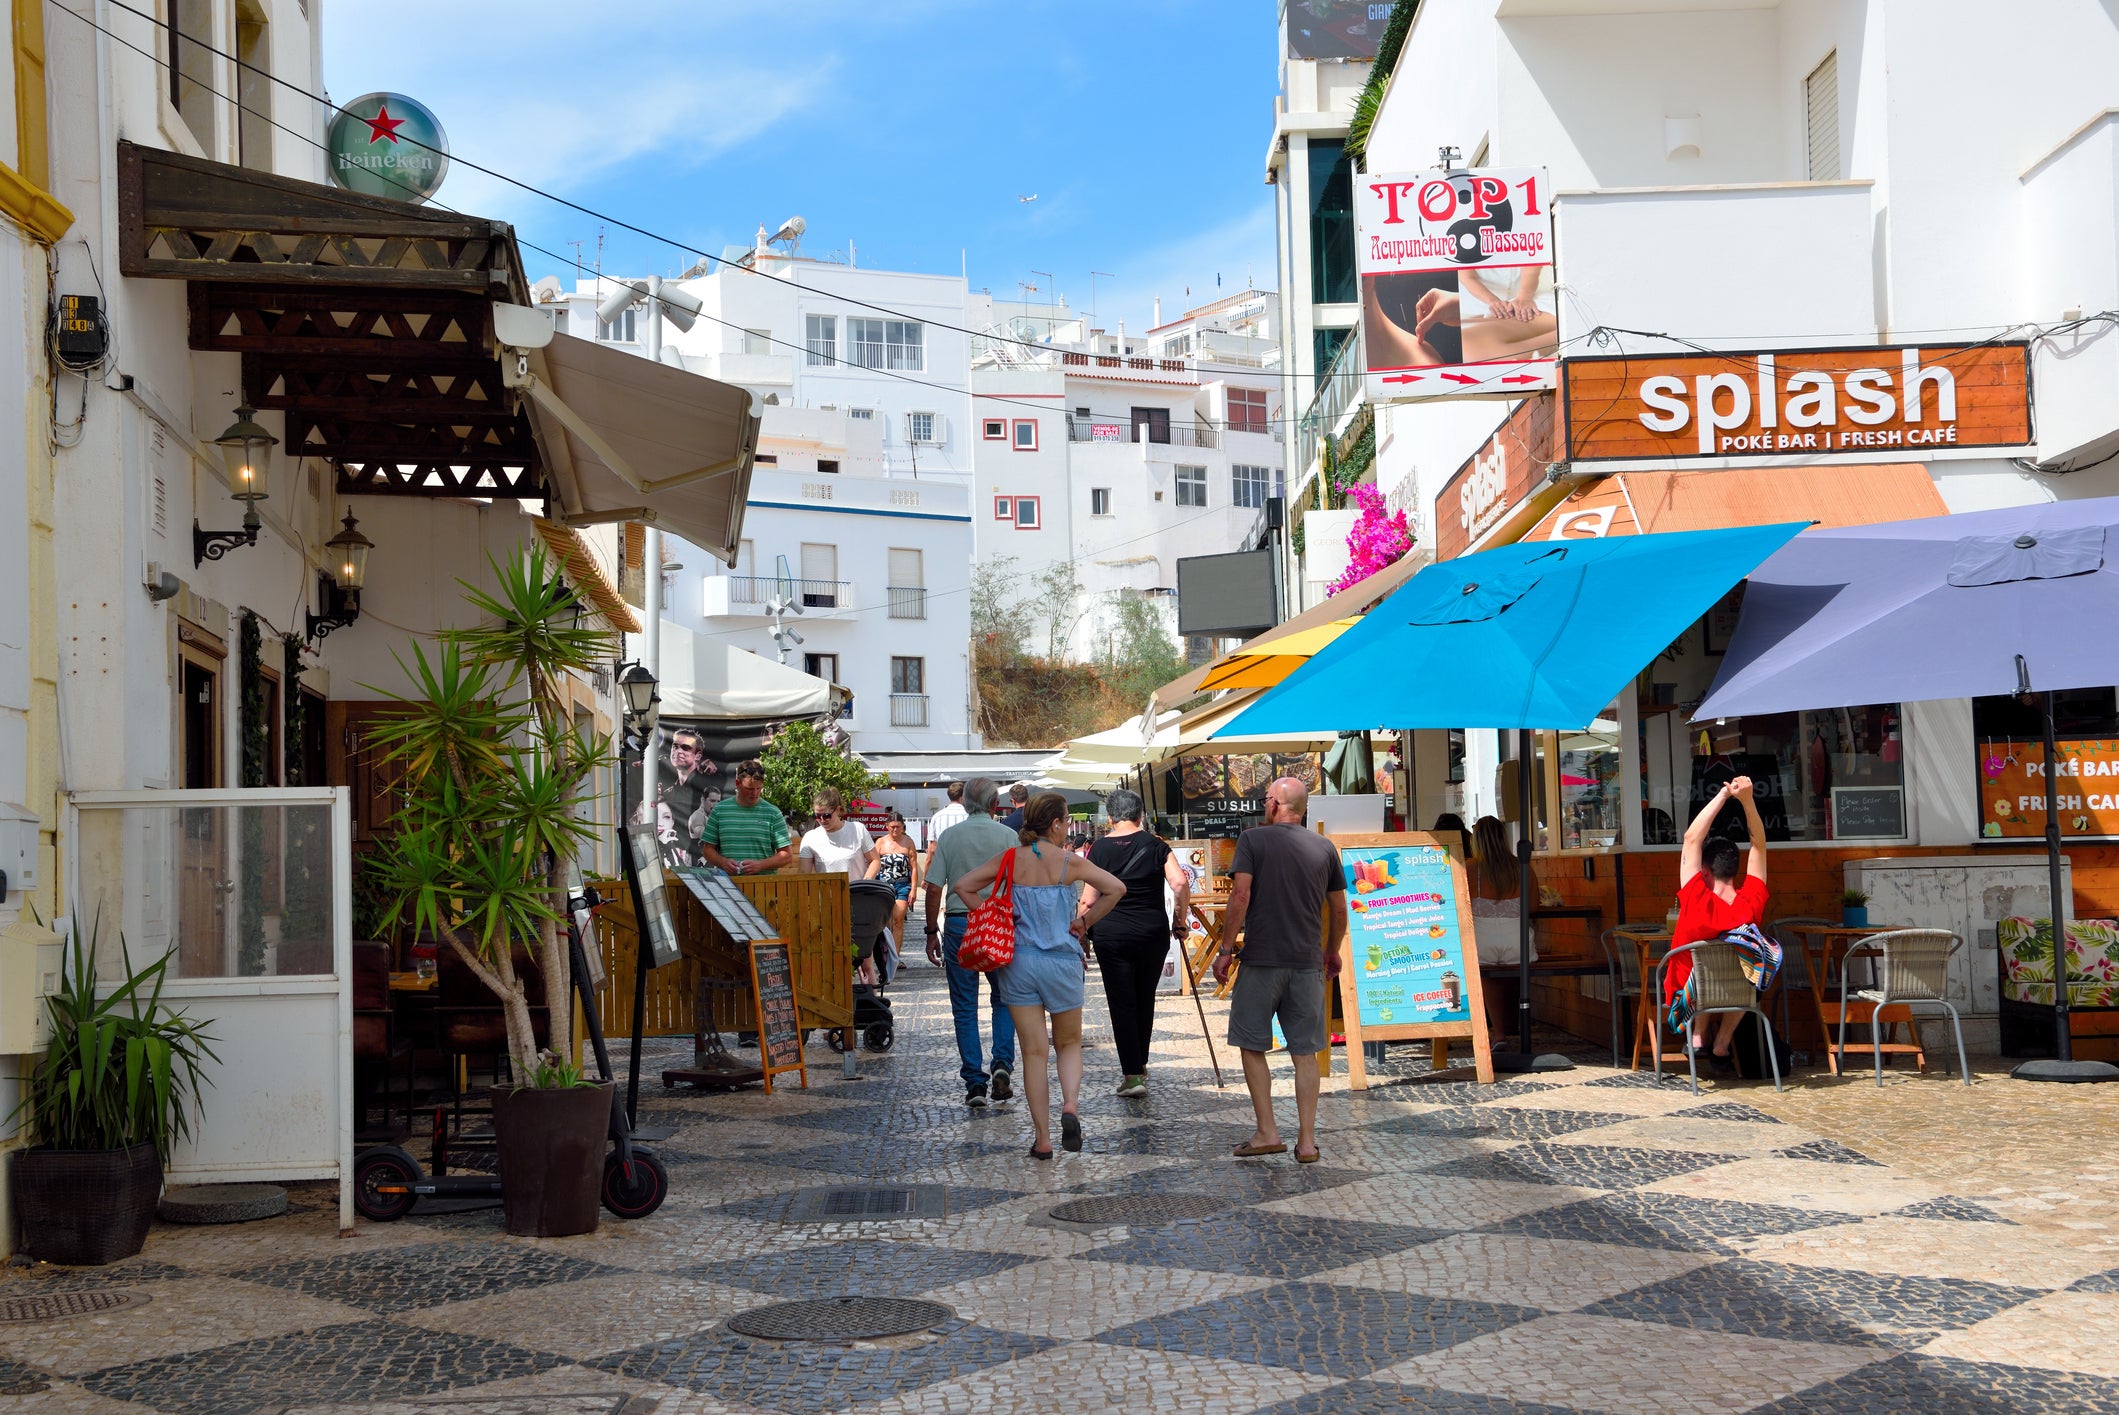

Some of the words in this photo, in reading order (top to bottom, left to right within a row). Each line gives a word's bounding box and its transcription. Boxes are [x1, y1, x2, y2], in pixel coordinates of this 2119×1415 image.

[338, 152, 433, 170] Heineken
[1371, 233, 1456, 264] Acupuncture
[1481, 228, 1544, 256] Massage
[1639, 348, 1957, 453] splash
[1721, 430, 1772, 451] POKÉ
[1778, 434, 1817, 449] BAR
[1841, 429, 1902, 448] FRESH
[1906, 425, 1957, 445] CAFÉ
[1207, 800, 1257, 812] SUSHI
[1404, 853, 1444, 867] splash
[1367, 898, 1388, 908] FRUIT
[1389, 892, 1430, 906] SMOOTHIES
[1362, 912, 1382, 920] Mango
[1383, 909, 1402, 917] Dream
[1420, 904, 1441, 912] Berries
[1363, 922, 1386, 931] Tropical
[1387, 920, 1405, 929] Tango
[1408, 916, 1428, 925] Jungle
[1428, 914, 1444, 922] Juice
[1384, 930, 1407, 940] Tropical
[1383, 945, 1406, 960] DETOX
[1389, 952, 1431, 966] SMOOTHIES
[1366, 970, 1391, 979] Morning
[1391, 967, 1407, 976] Glory
[1430, 960, 1454, 968] Passion
[1413, 994, 1425, 1002] ICE
[1426, 989, 1452, 1000] COFFEE
[1416, 1001, 1454, 1012] Frappuccino
